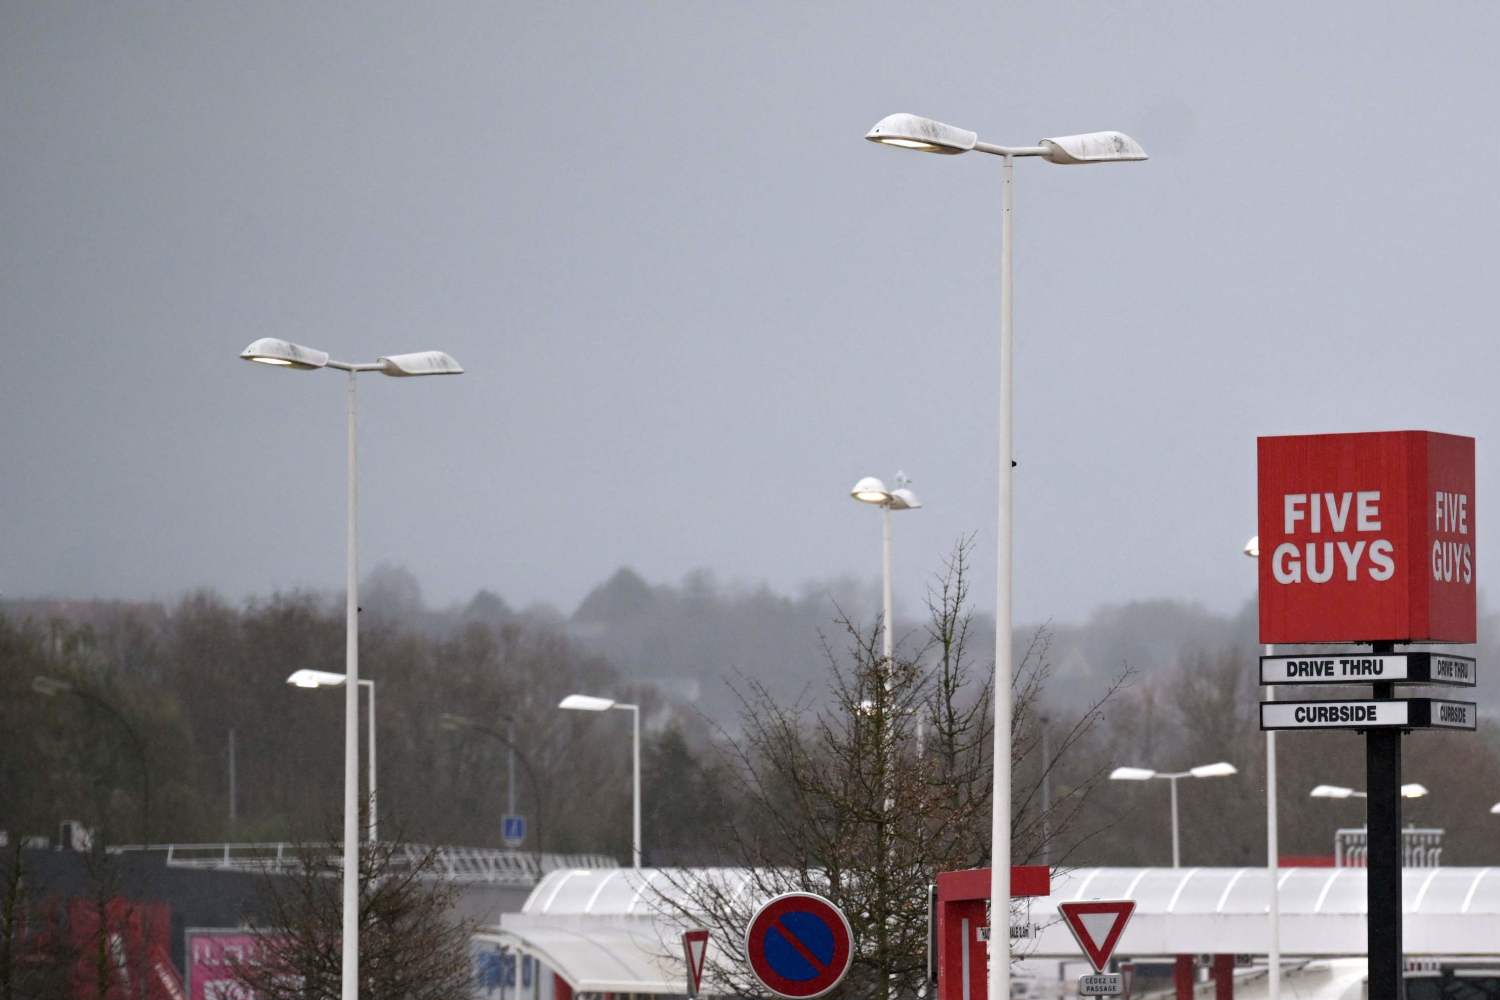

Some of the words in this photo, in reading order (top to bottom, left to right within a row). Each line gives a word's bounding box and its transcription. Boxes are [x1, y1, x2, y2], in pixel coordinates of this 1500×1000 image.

[1284, 491, 1382, 534] FIVE
[1435, 491, 1467, 535] FIVE
[1271, 539, 1395, 584] GUYS
[1432, 540, 1472, 584] GUYS
[1286, 660, 1335, 677] DRIVE
[1340, 659, 1384, 676] THRU
[1437, 660, 1453, 677] DRIVE
[1454, 662, 1468, 679] THRU
[1294, 705, 1377, 723] CURBSIDE
[1440, 705, 1467, 723] CURBSIDE
